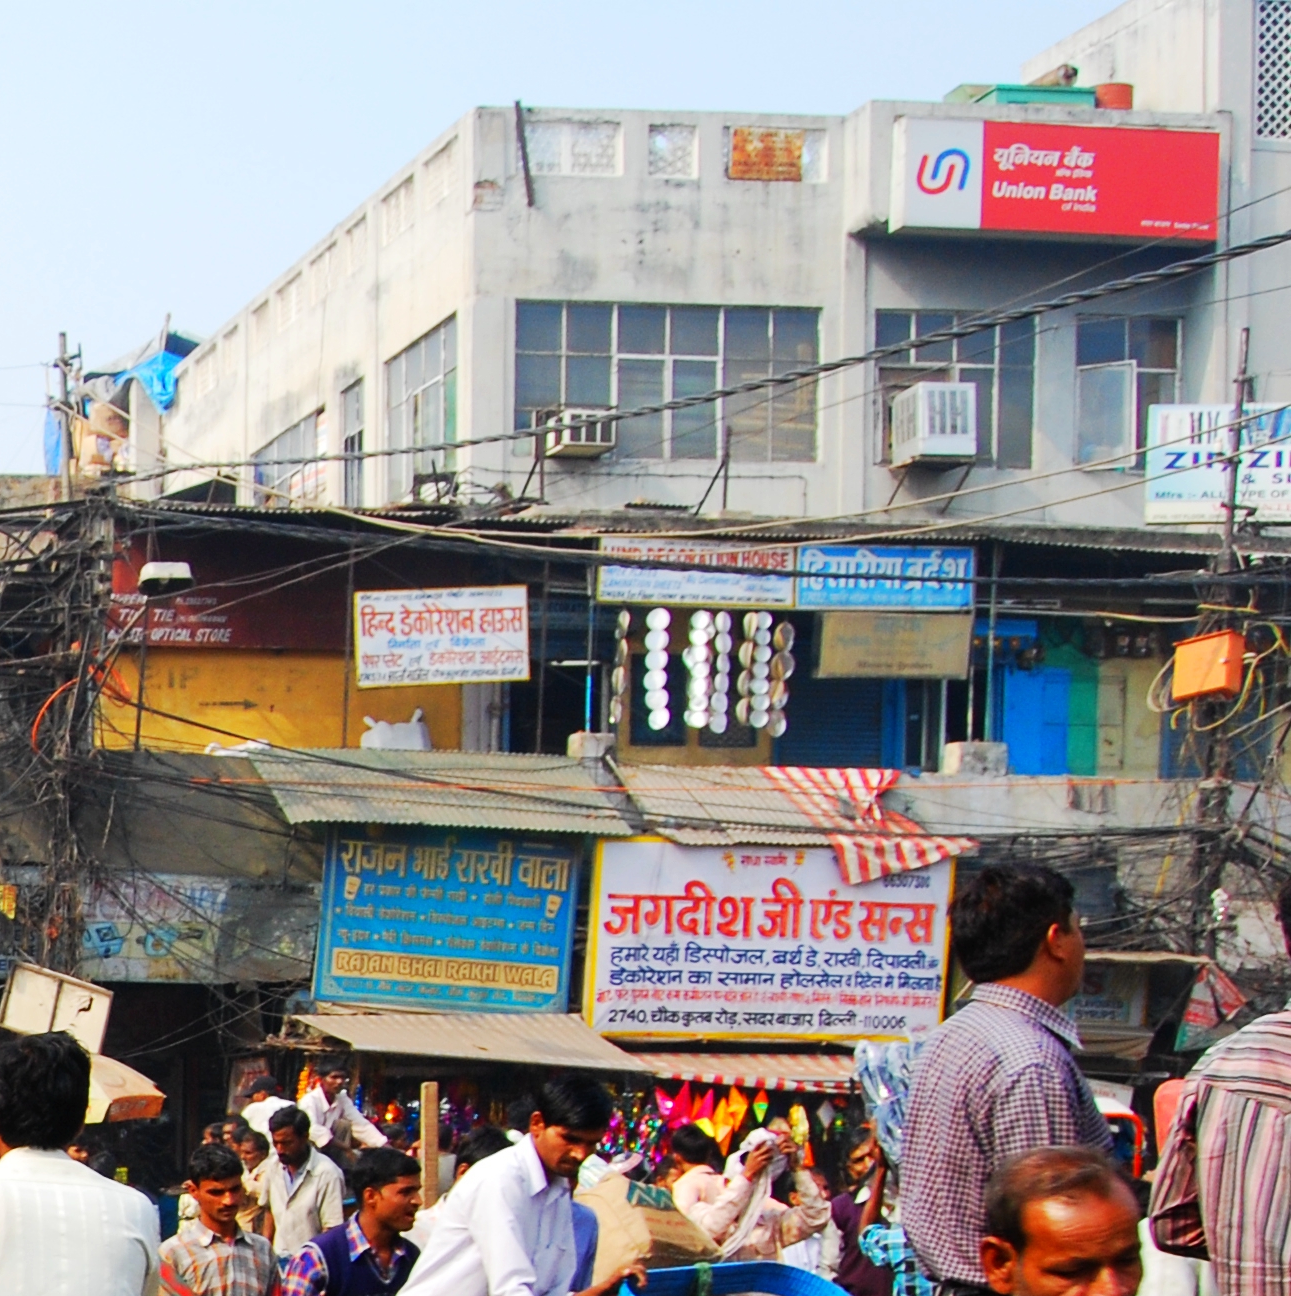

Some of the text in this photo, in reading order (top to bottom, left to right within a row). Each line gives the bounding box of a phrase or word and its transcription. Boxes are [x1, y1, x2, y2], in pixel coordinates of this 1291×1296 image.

[993, 143, 1095, 170] यूनियन बैंक
[991, 180, 1098, 201] Union Bank
[742, 550, 789, 569] HOUSE
[360, 603, 395, 638] हिन्द
[399, 601, 474, 636] डेकोरेशन
[194, 627, 233, 642] STORE
[340, 838, 408, 878] राजन
[412, 833, 458, 881] भाई
[517, 855, 570, 892] वाला
[603, 877, 937, 944] जगदीश जी एंड सन्स
[610, 943, 651, 968] हमारे
[652, 941, 680, 967] यहाँ
[336, 952, 555, 988] RAJAN BHAI RAKHI WALA
[688, 969, 712, 985] का
[718, 971, 775, 987] सामान
[780, 968, 843, 990] होलसेल
[608, 1009, 649, 1025] 2740,
[651, 1006, 681, 1023] चौक
[818, 1009, 857, 1027] दिल्ली
